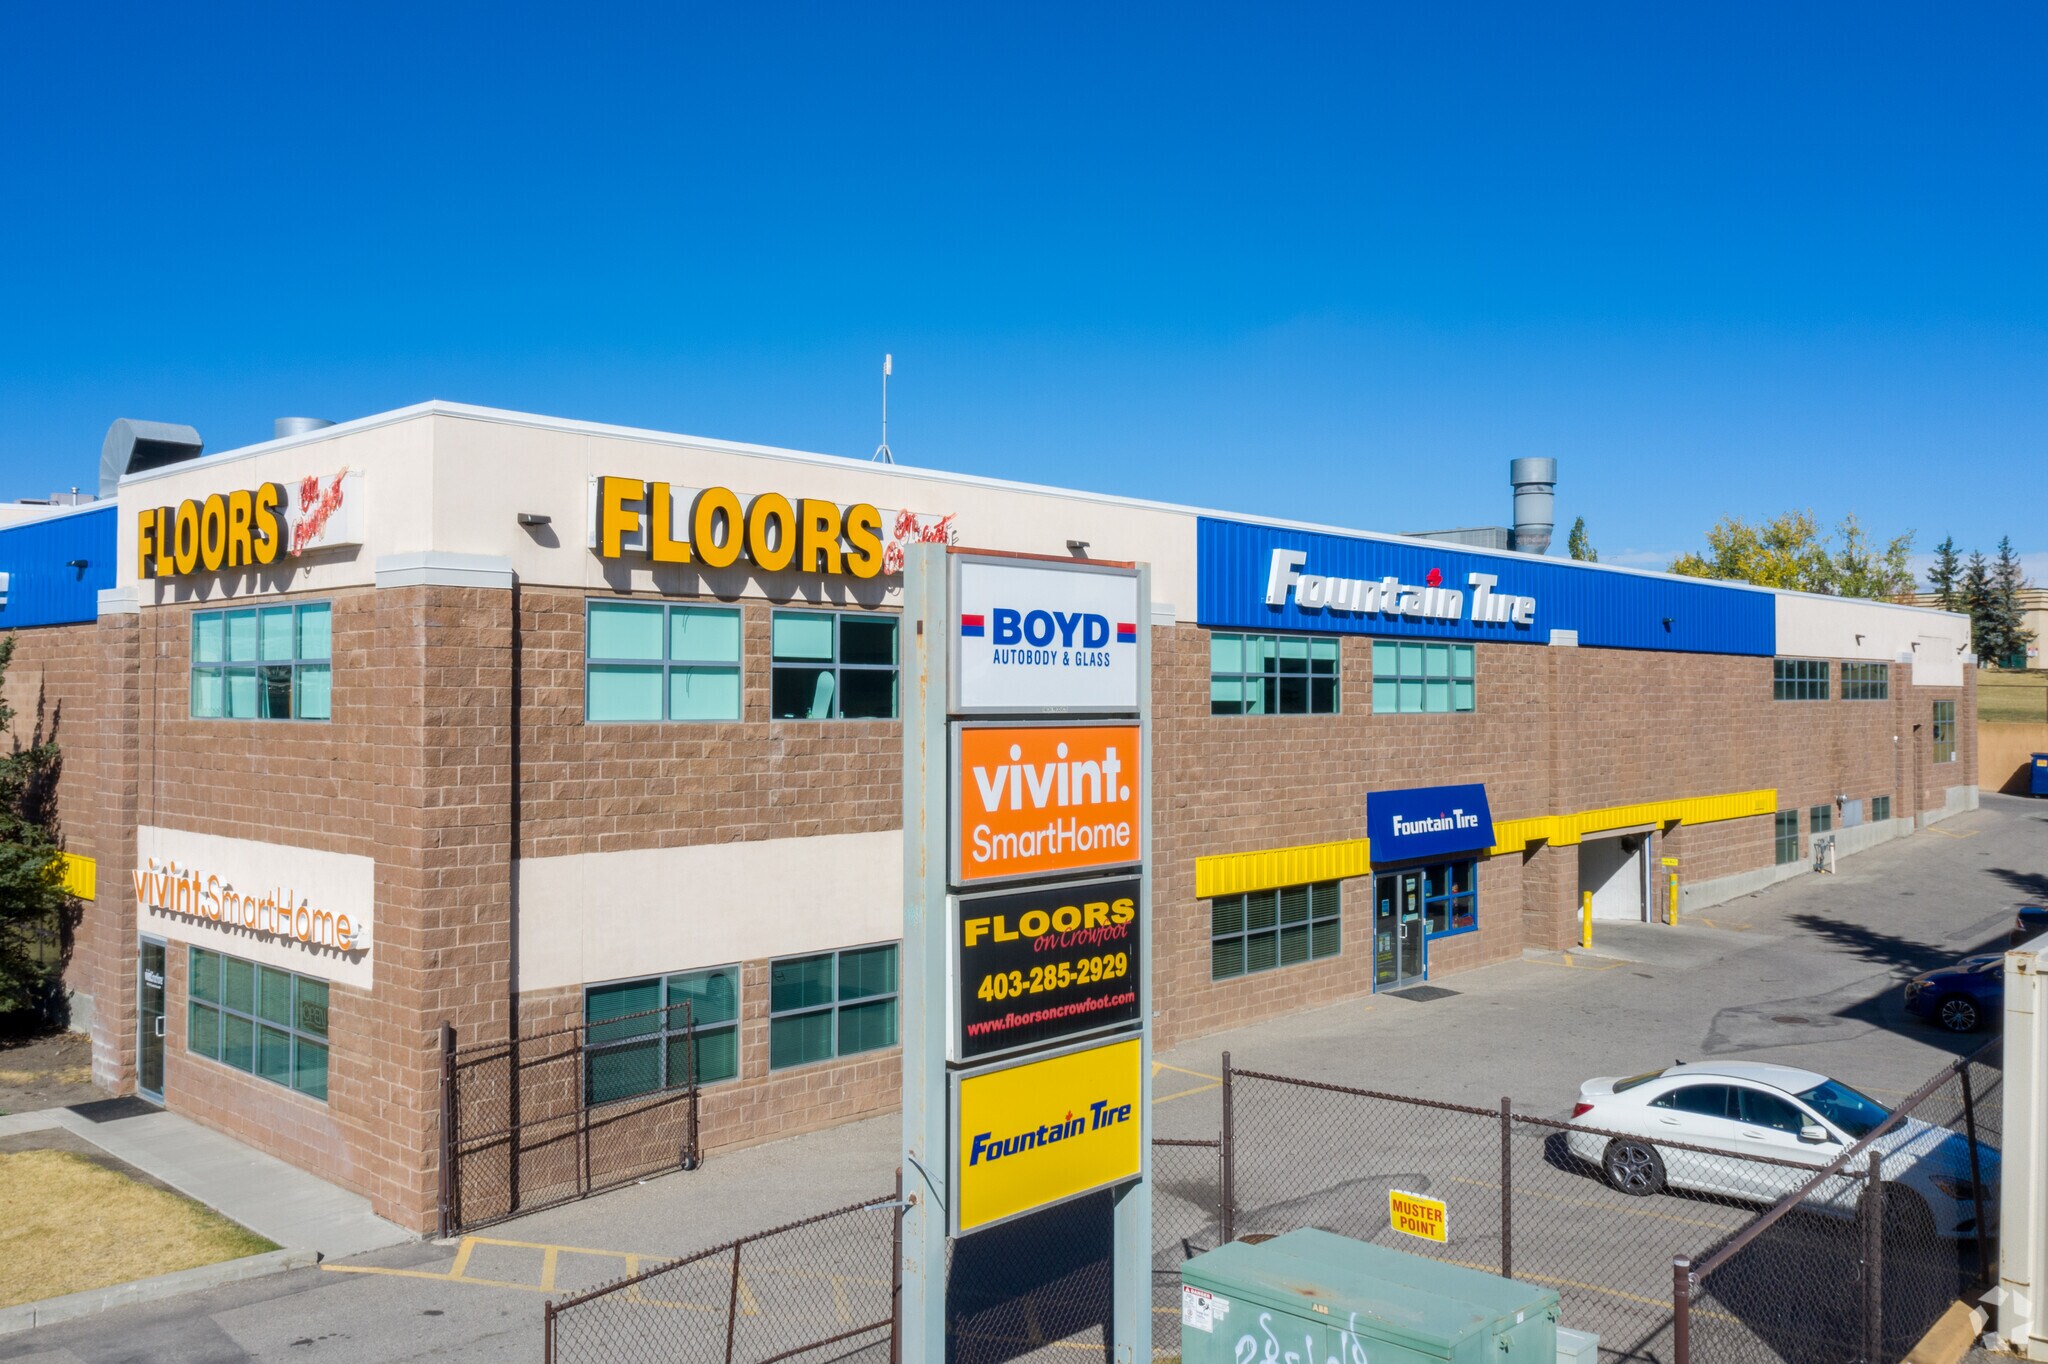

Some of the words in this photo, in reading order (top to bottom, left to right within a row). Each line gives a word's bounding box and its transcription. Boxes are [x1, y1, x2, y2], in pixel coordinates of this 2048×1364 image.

[139, 482, 280, 579] FLOORS
[600, 475, 883, 579] FLOORS
[1266, 548, 1463, 620] Fountain
[1468, 572, 1536, 625] Tire
[992, 607, 1110, 649] BOYD
[993, 649, 1057, 666] AUTOBODY
[1062, 651, 1070, 666] &
[1075, 652, 1110, 667] GLASS
[973, 742, 1130, 812] vivint.
[972, 817, 1130, 862] SmartHome
[1393, 814, 1454, 837] Fountain
[1453, 808, 1479, 829] Tire
[964, 898, 1135, 947] FLOORS
[1033, 932, 1060, 952] on
[1060, 918, 1132, 949] Crowfoot
[977, 951, 1128, 1002] 403-285-2929
[966, 991, 1135, 1037] www.floorsoncrowfoot.com
[969, 1115, 1085, 1167] Fountain
[1089, 1100, 1132, 1131] Tire
[1392, 1199, 1442, 1222] MUSTER
[1400, 1216, 1436, 1236] POINT
